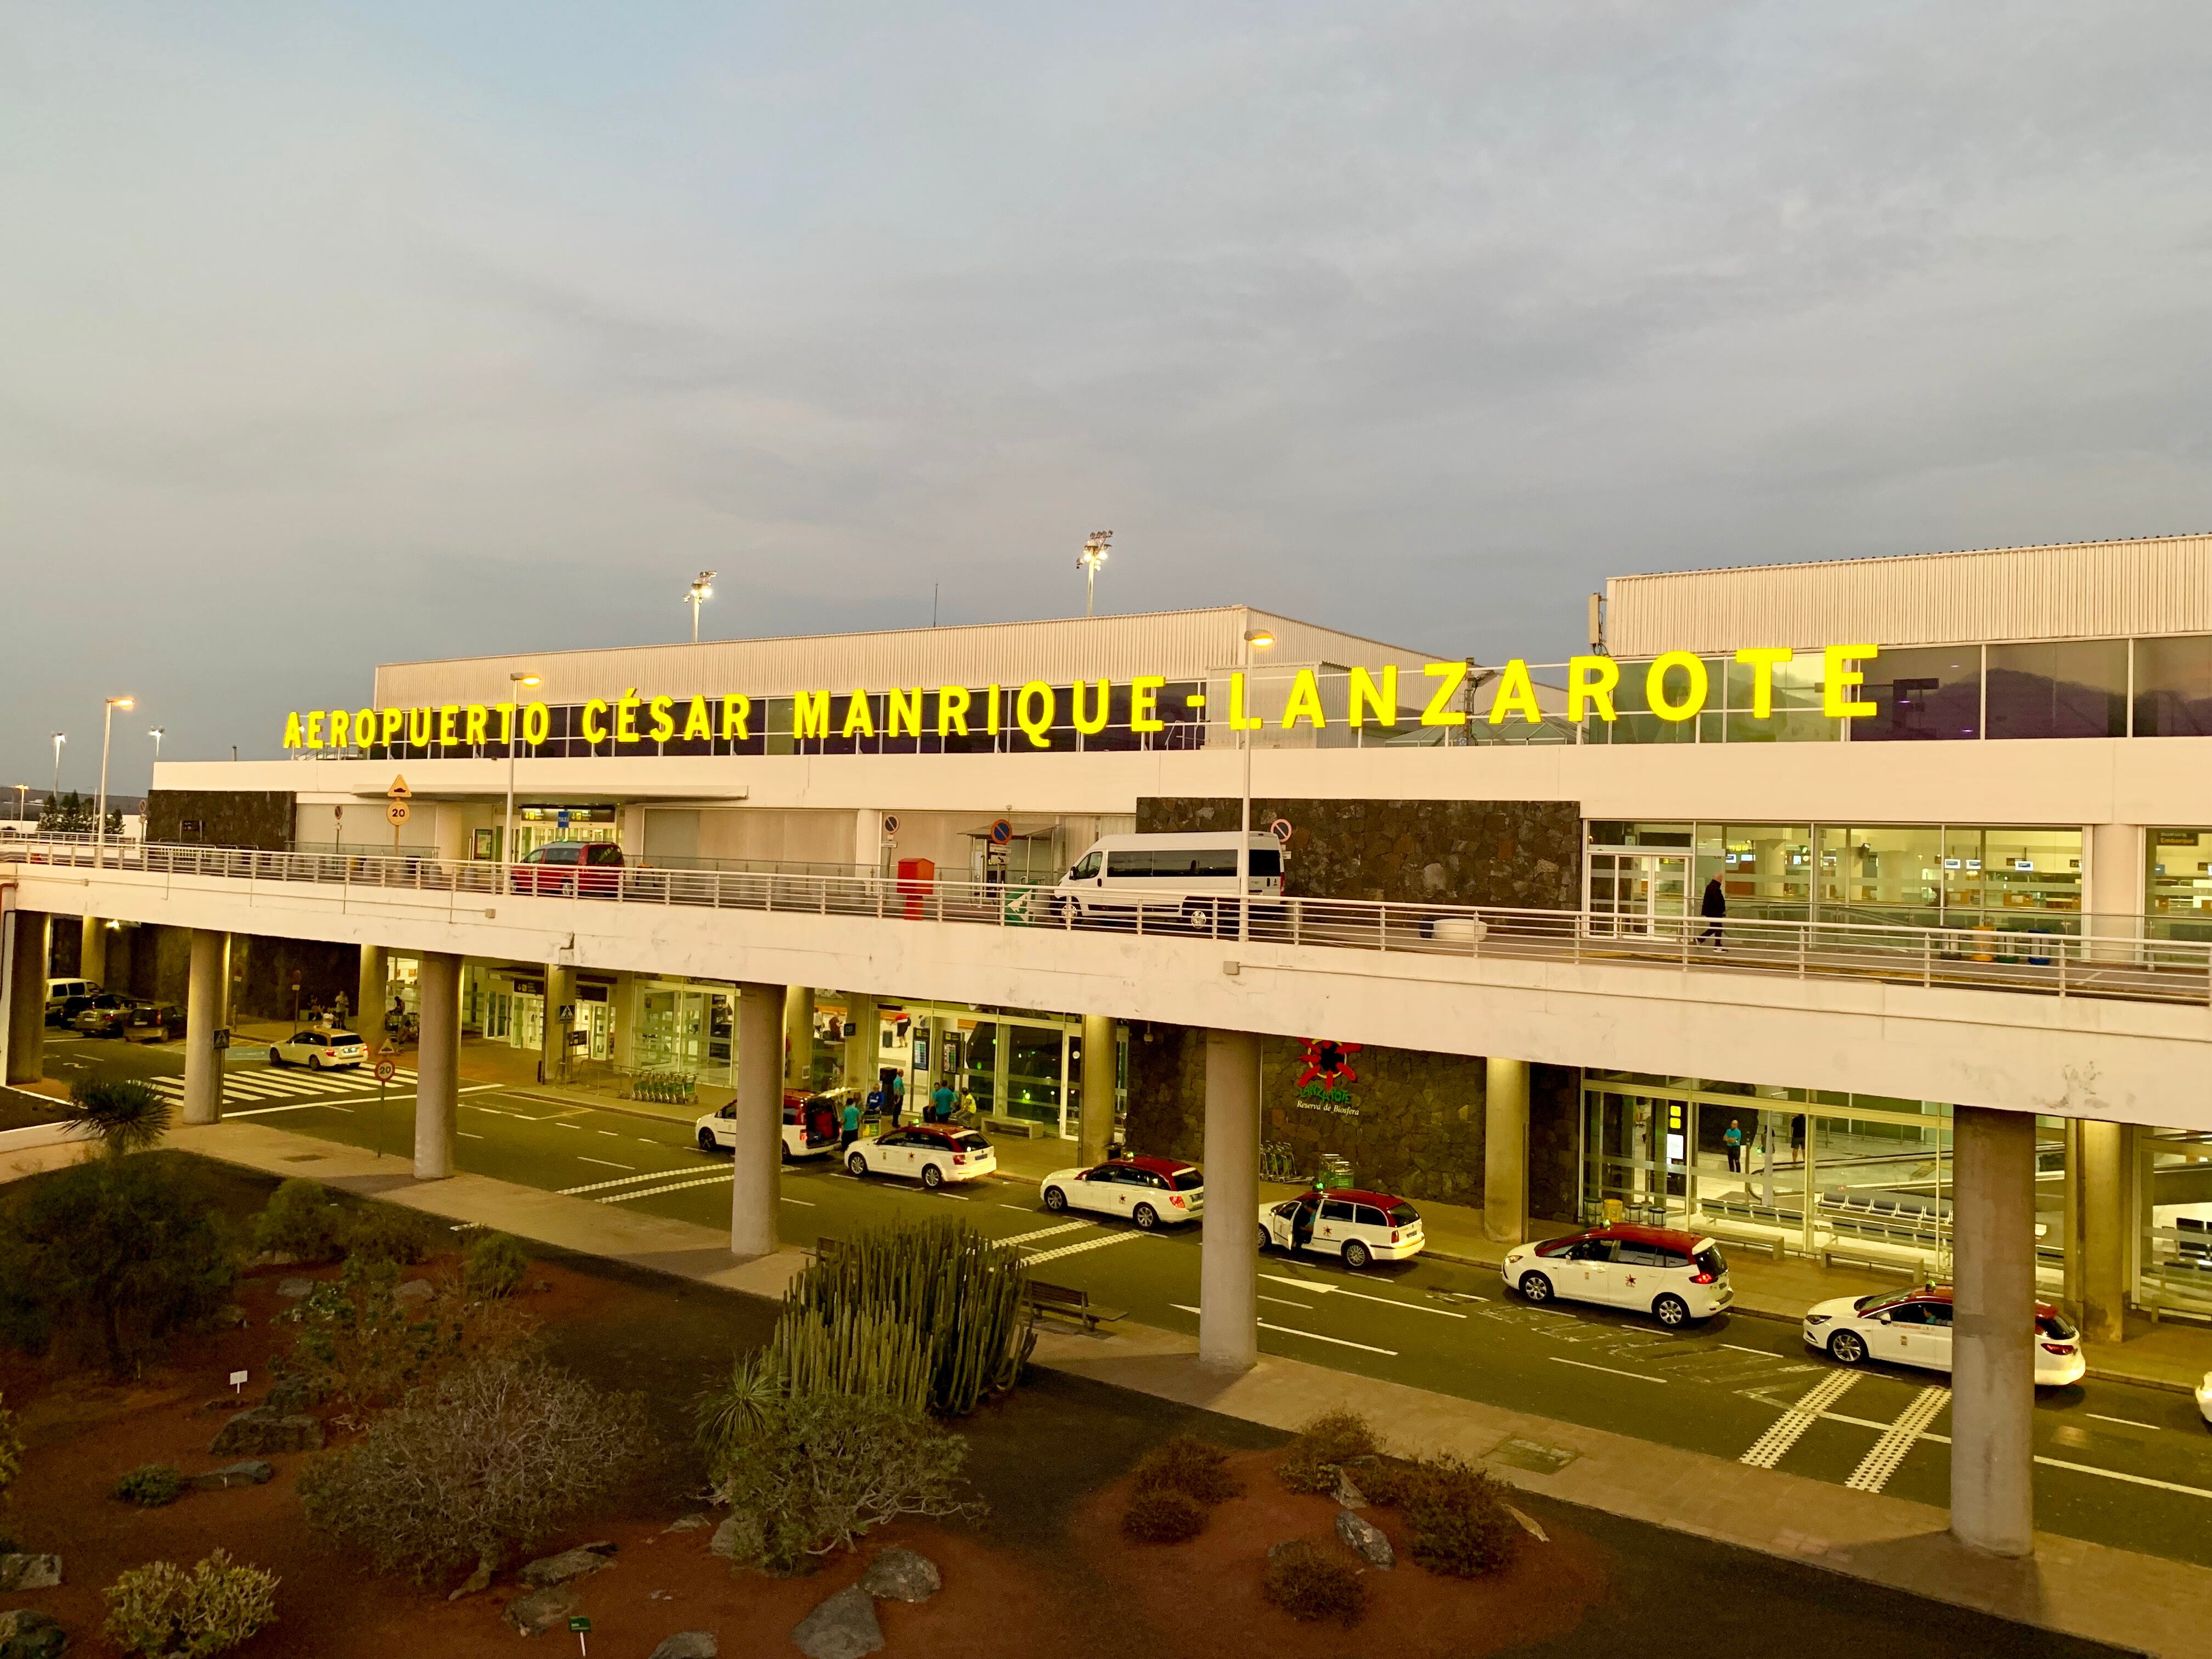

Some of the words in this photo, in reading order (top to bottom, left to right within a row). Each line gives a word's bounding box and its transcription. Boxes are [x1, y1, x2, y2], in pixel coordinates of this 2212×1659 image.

[282, 701, 551, 749] AEROPUERTO
[581, 687, 751, 744] CÉSAR
[792, 675, 1166, 748] MANRIQUE
[1228, 642, 1879, 731] LANZAROTE
[392, 808, 405, 817] 20
[379, 1066, 391, 1075] 20
[1296, 1100, 1321, 1110] Reserva
[1323, 1103, 1331, 1111] de
[1333, 1104, 1360, 1116] Biosfera
